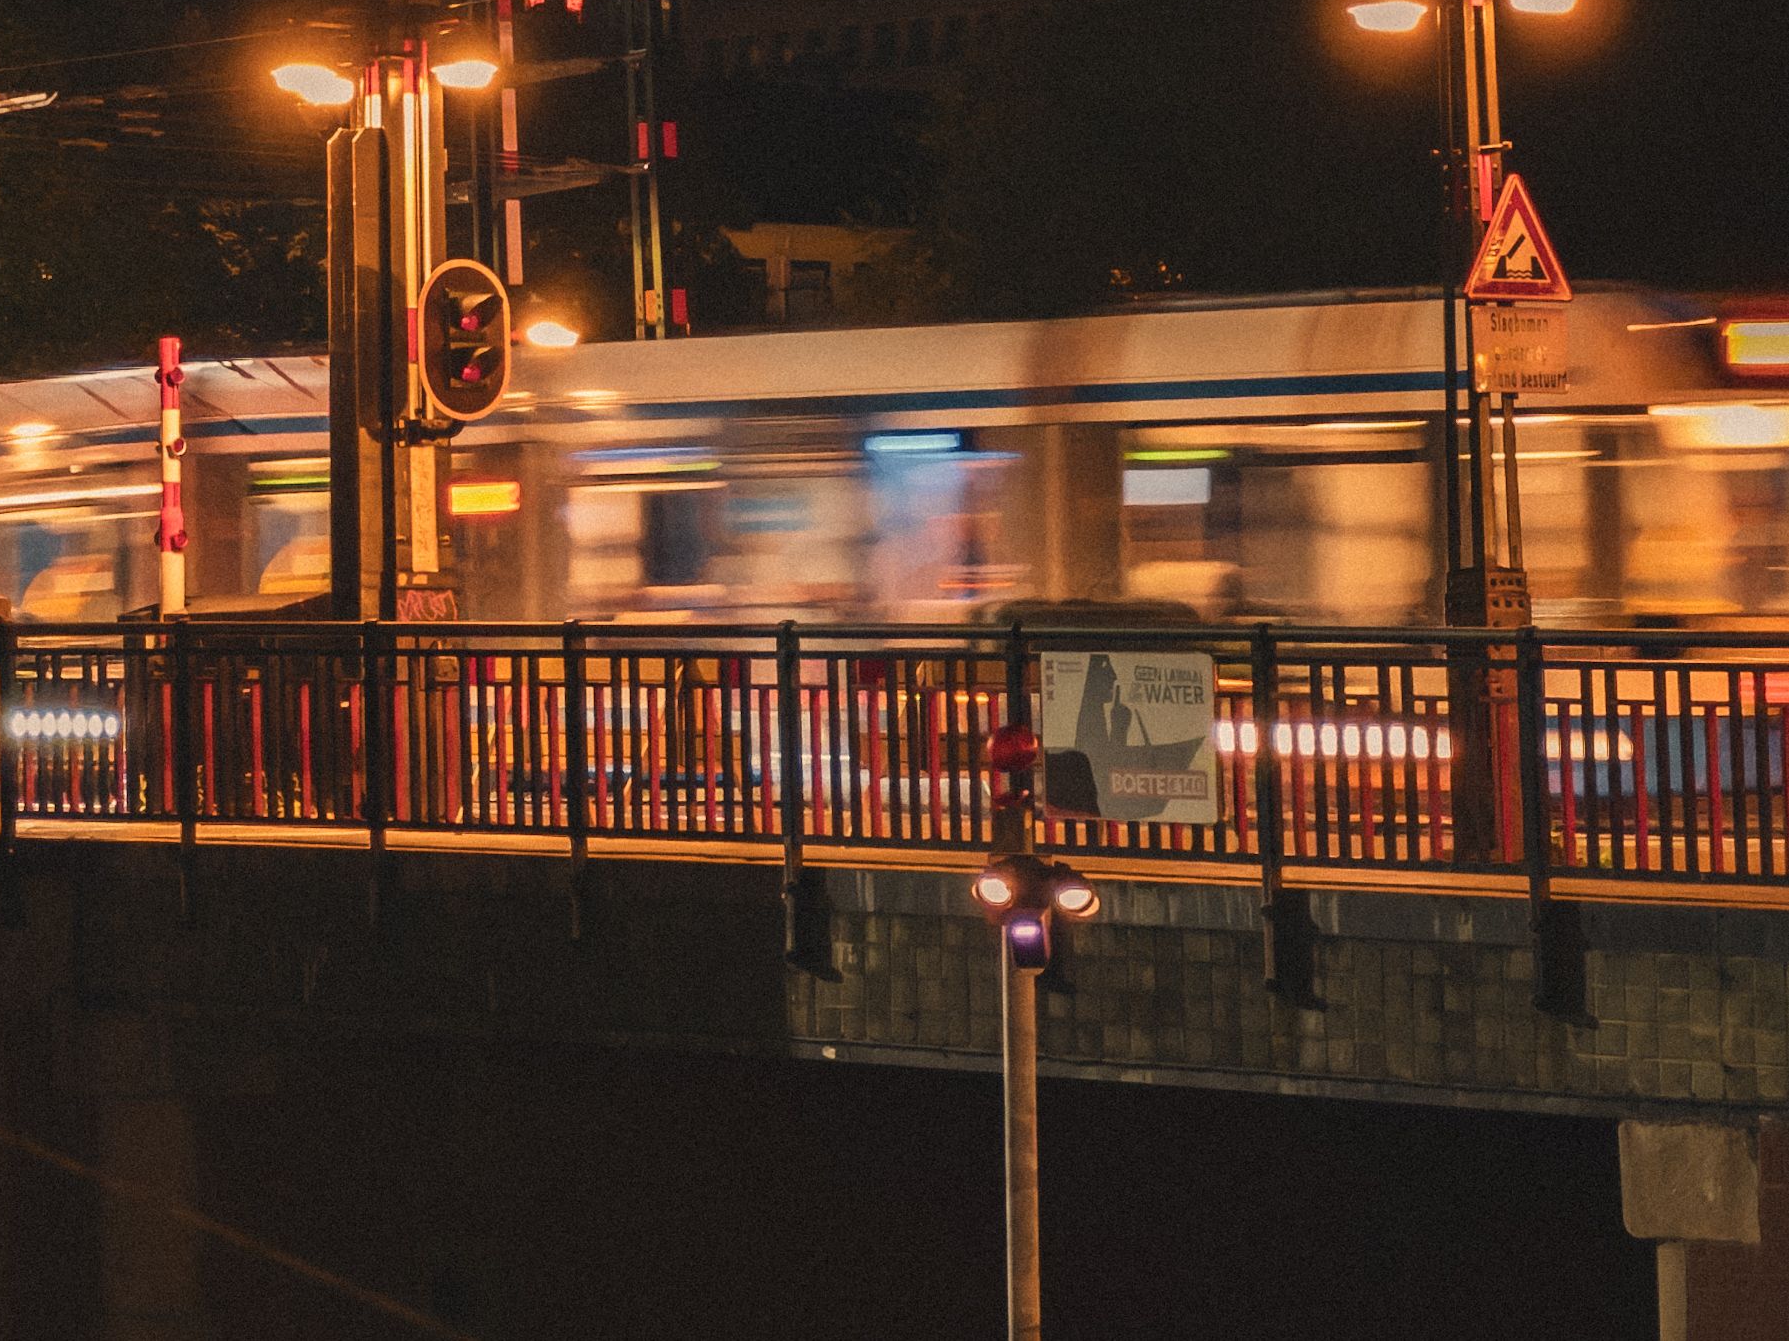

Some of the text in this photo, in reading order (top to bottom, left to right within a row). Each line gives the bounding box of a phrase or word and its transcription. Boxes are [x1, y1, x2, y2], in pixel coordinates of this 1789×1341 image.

[1490, 312, 1549, 336] Slagbomen
[1143, 684, 1205, 705] WATER
[1112, 772, 1167, 795] BOETE
